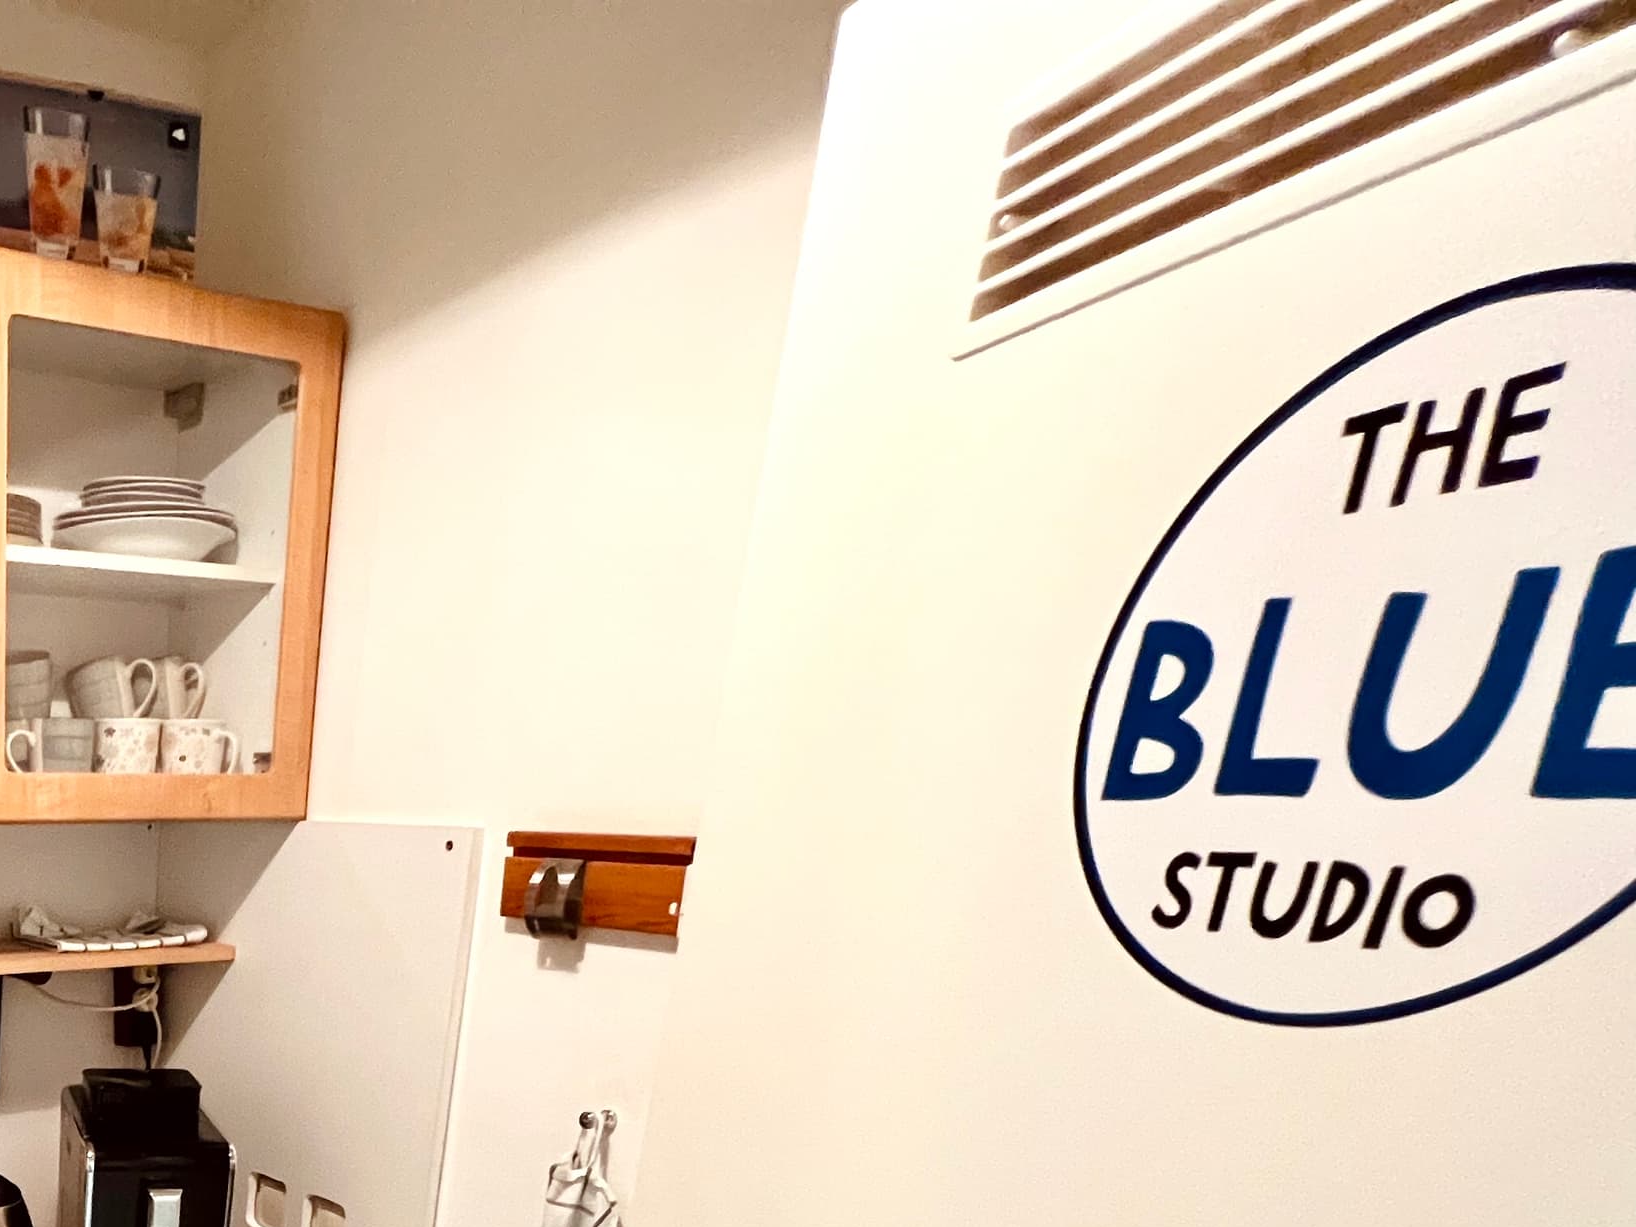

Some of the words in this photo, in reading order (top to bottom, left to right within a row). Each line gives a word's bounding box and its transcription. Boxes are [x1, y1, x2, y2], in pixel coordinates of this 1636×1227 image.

[1342, 361, 1567, 515] THE
[1101, 545, 1636, 801] BLUE
[1151, 851, 1476, 950] STUDIO
